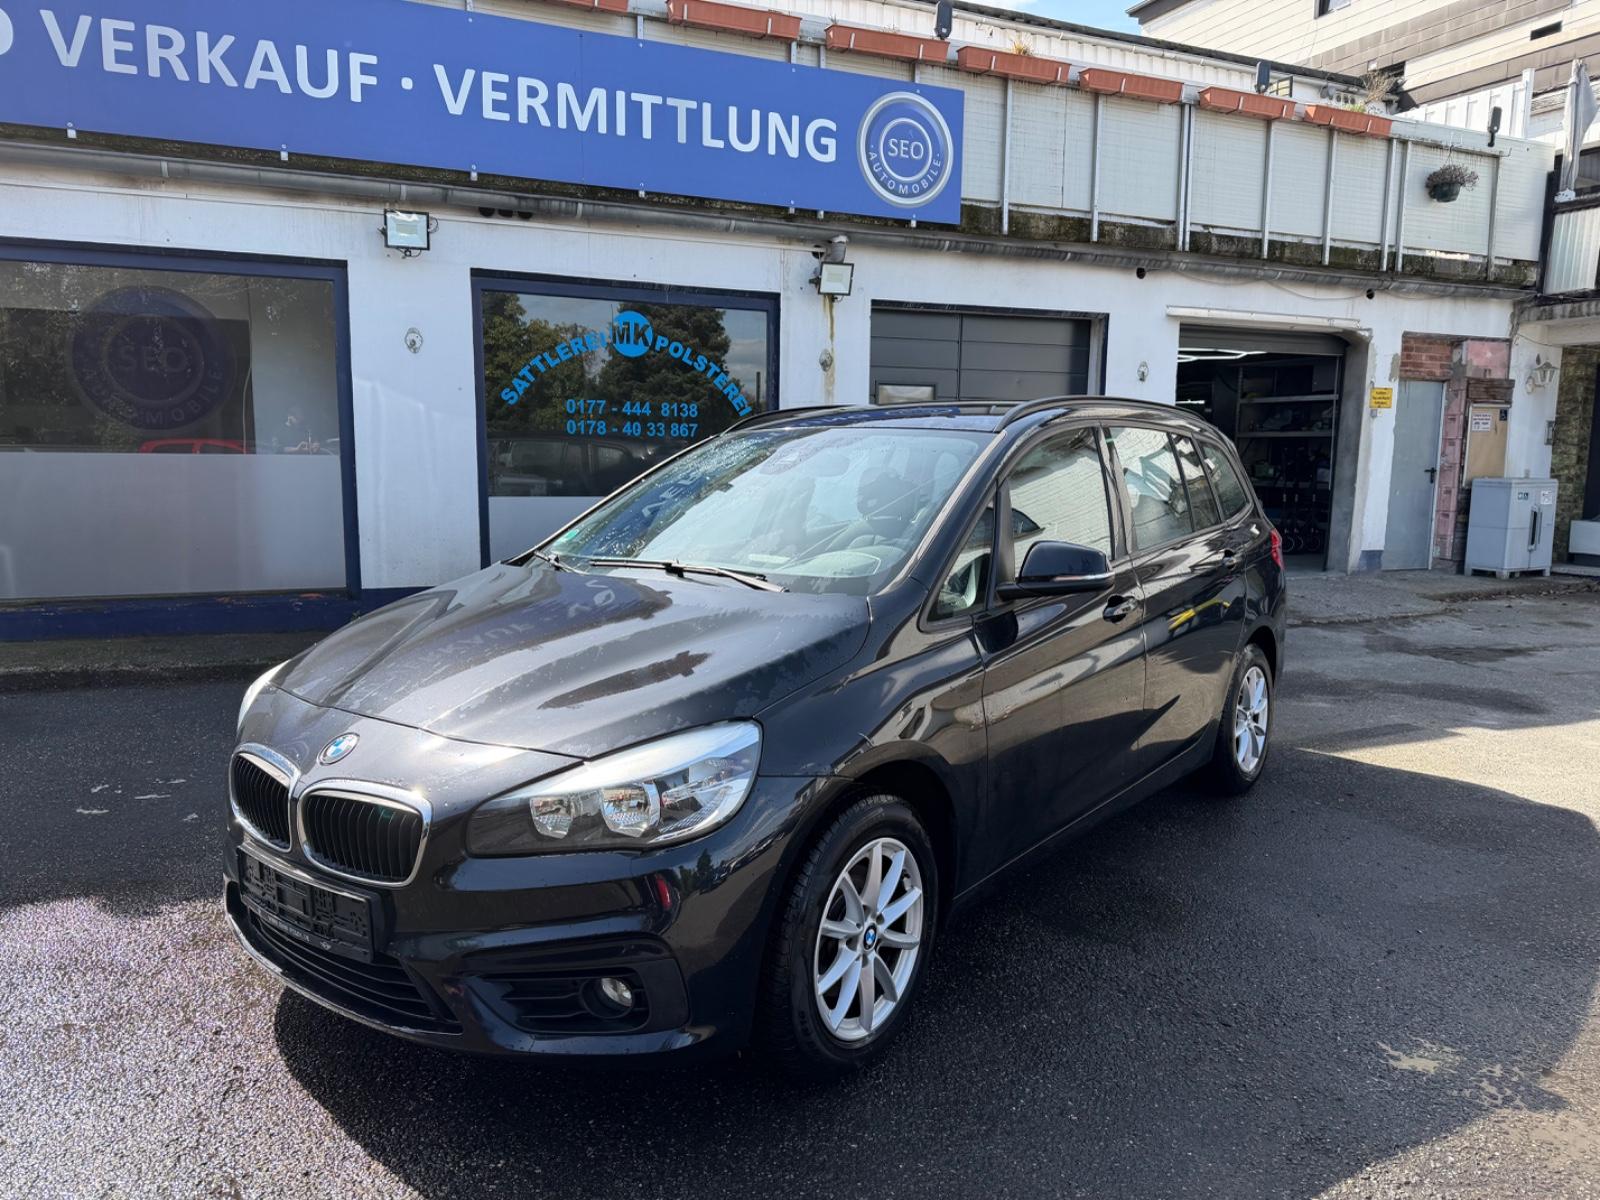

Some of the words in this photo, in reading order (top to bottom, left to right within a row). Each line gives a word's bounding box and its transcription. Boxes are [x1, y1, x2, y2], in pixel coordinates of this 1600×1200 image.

[40, 9, 378, 102] VERKAUF
[433, 63, 838, 163] VERMITTLUNG
[888, 138, 924, 159] SEO
[868, 151, 941, 194] AUTOMOBILE
[612, 320, 652, 348] MK
[501, 332, 607, 405] SATTLEREI
[655, 335, 752, 416] POLSTEREI
[566, 399, 605, 415] 0177
[622, 401, 651, 417] 444
[661, 403, 698, 418] 8138
[566, 420, 605, 435] 0178
[623, 421, 641, 436] 40
[647, 423, 665, 437] 33
[670, 423, 698, 438] 867
